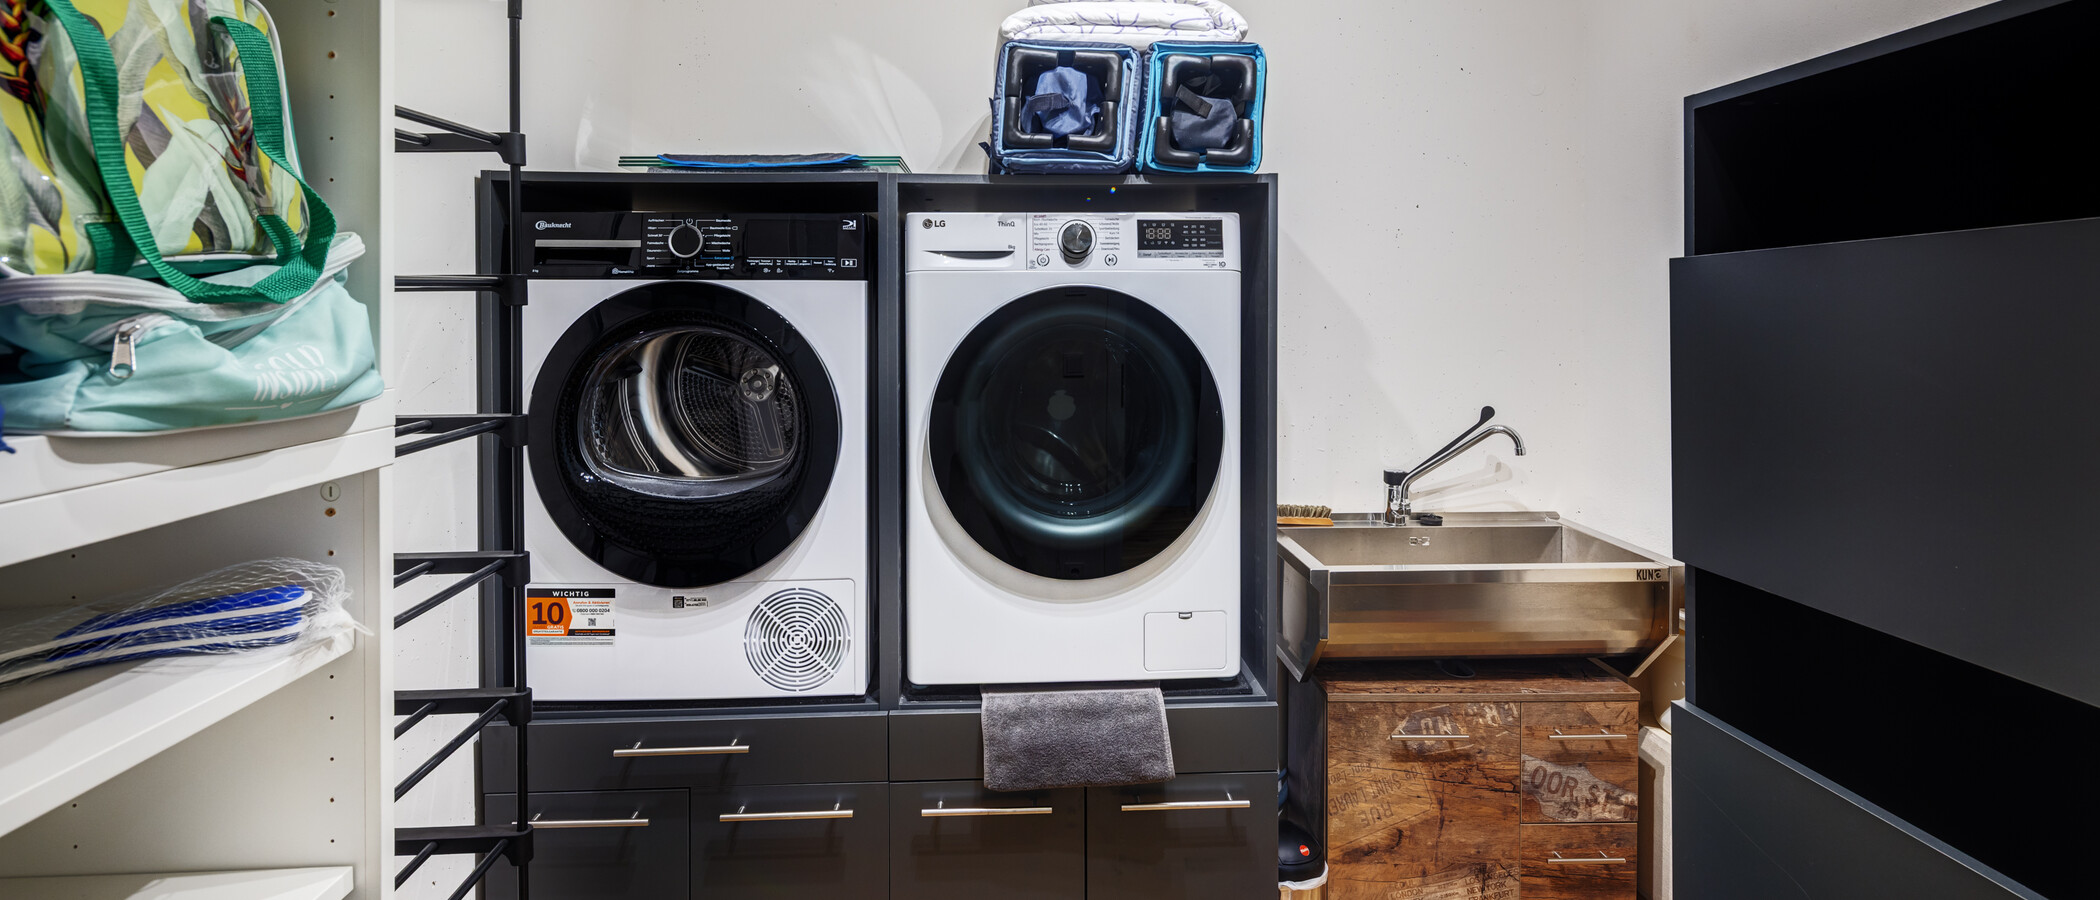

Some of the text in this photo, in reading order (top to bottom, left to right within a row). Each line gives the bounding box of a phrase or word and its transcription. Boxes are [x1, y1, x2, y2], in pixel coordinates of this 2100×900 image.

[535, 220, 572, 231] Bauknecht
[934, 220, 946, 228] LG
[997, 220, 1016, 228] ThinQ
[531, 601, 565, 625] 10
